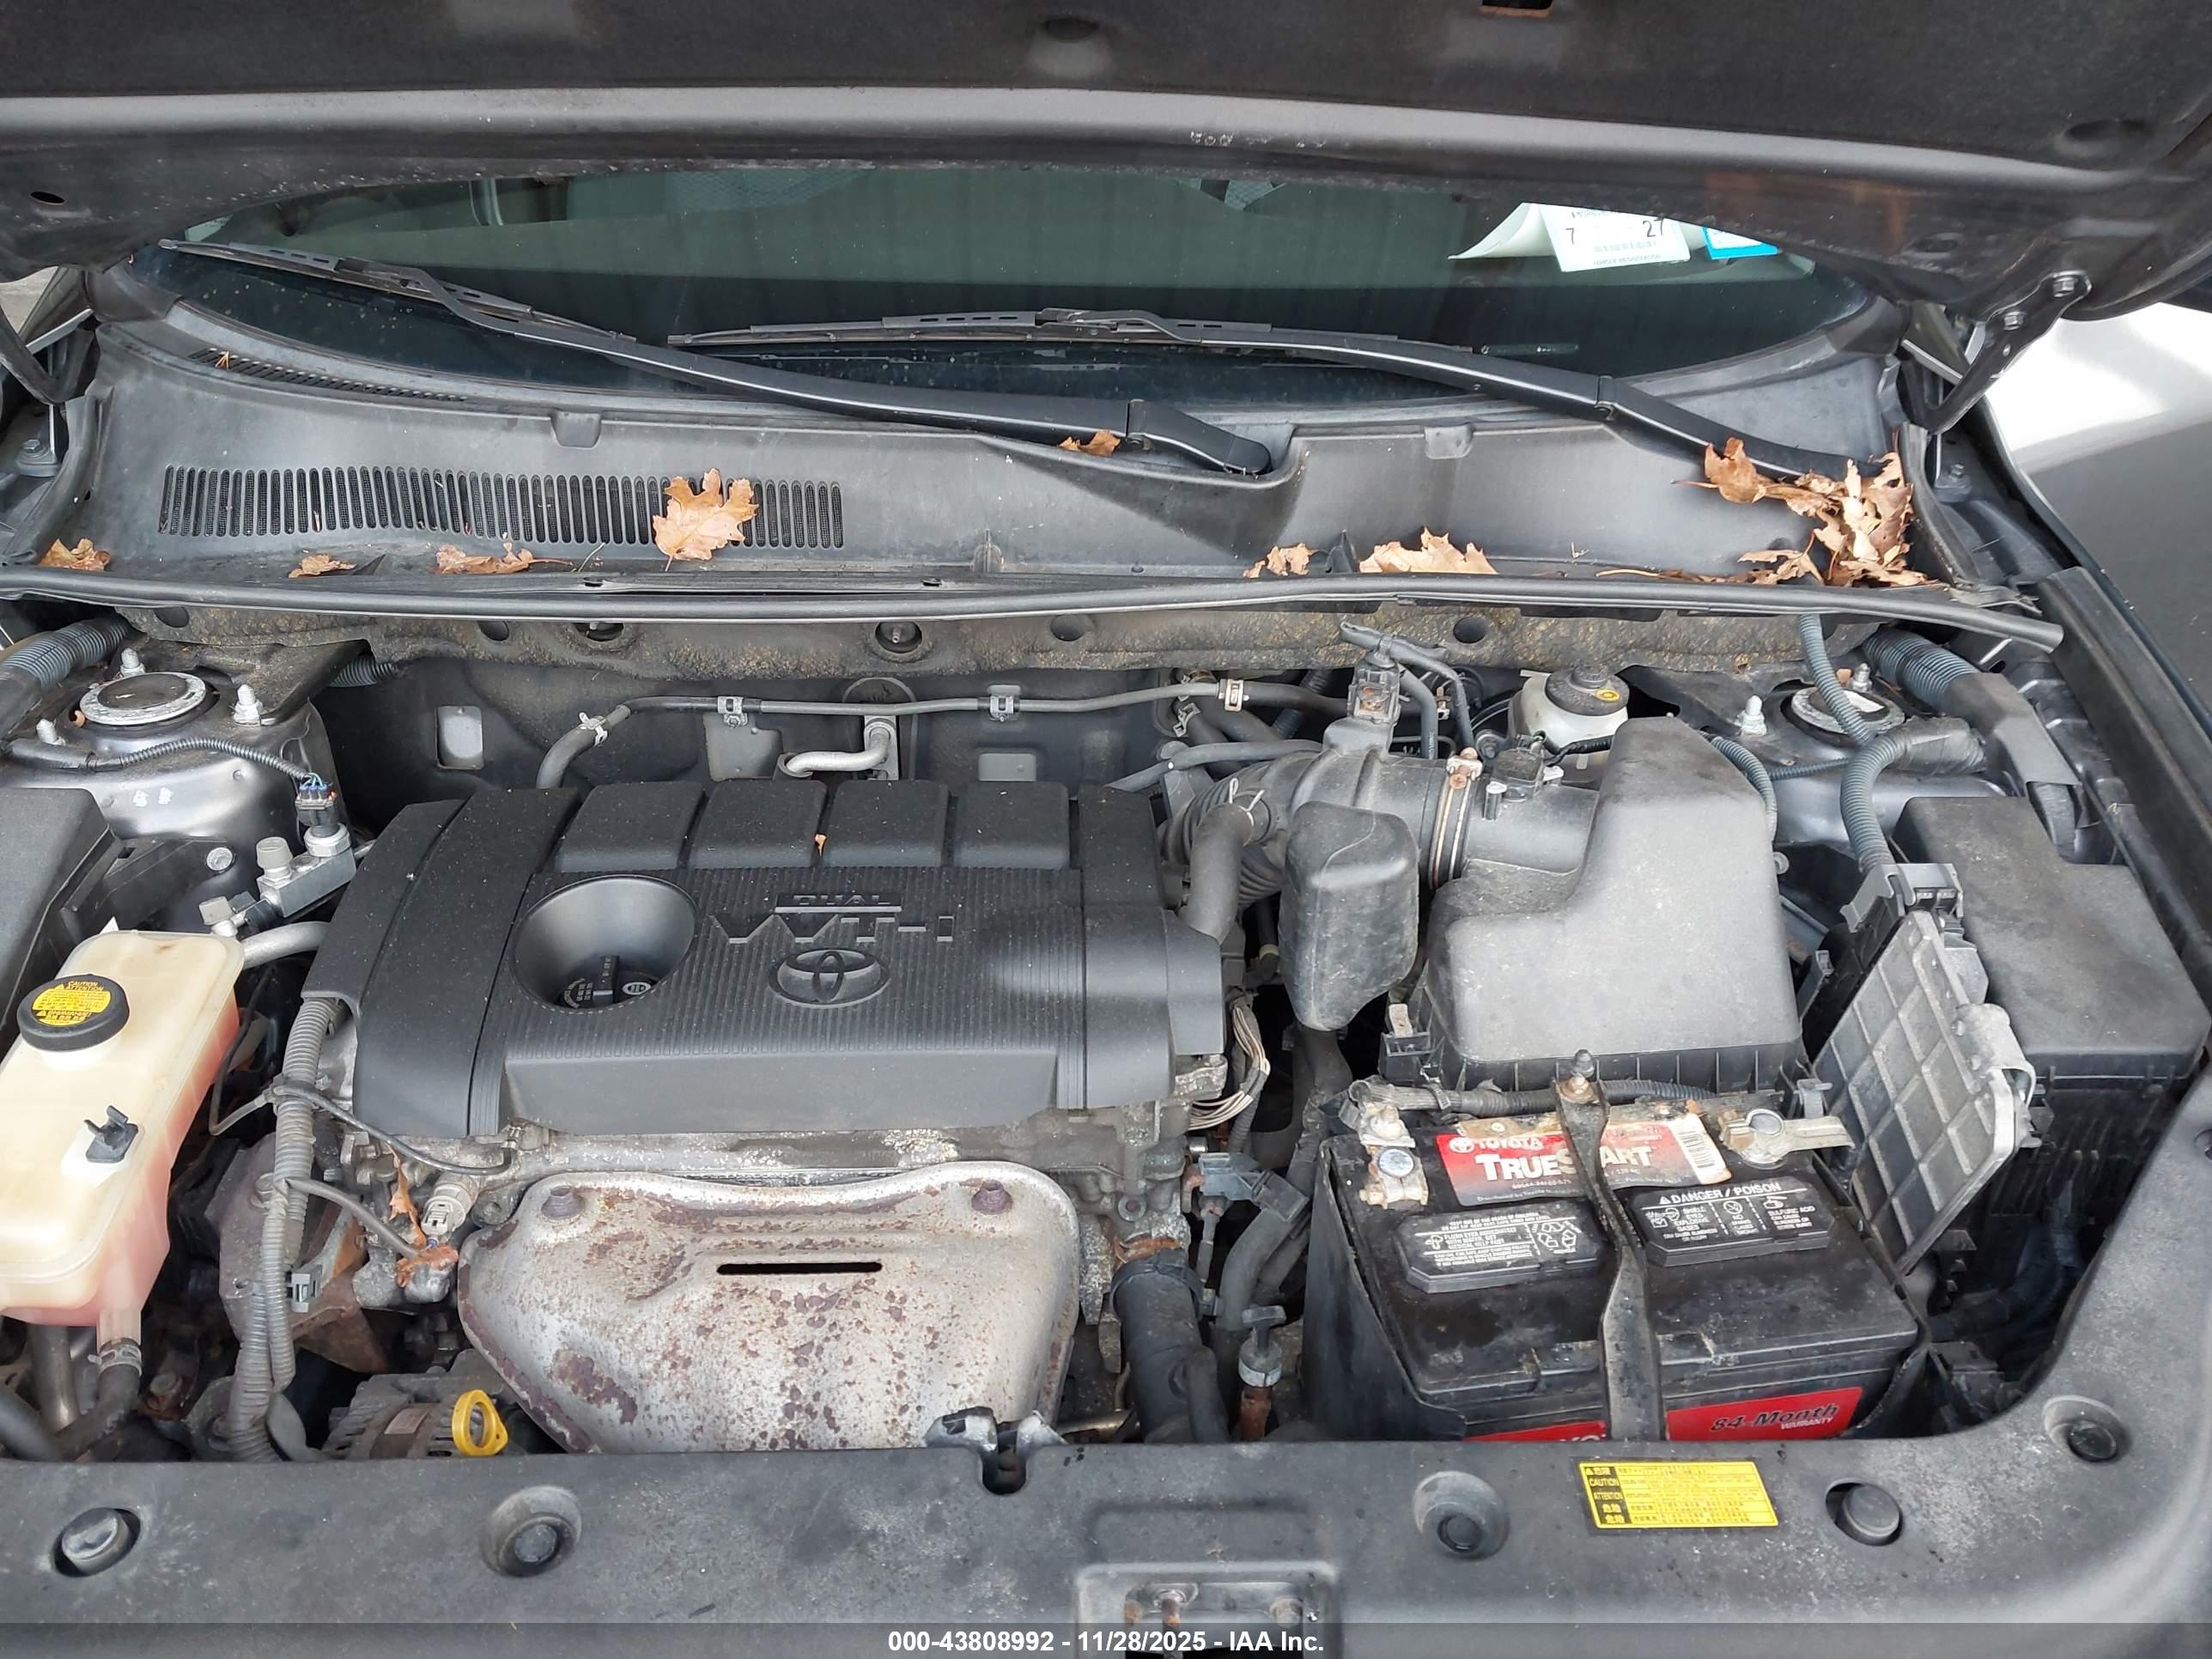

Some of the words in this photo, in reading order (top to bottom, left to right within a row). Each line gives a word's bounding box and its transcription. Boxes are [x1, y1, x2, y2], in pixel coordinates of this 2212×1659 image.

[1642, 217, 1665, 237] 27
[793, 895, 891, 906] DUAL
[1670, 1189, 1723, 1204] DANGER
[1733, 1182, 1782, 1196] POISON
[1589, 1478, 1620, 1486] CAUTION
